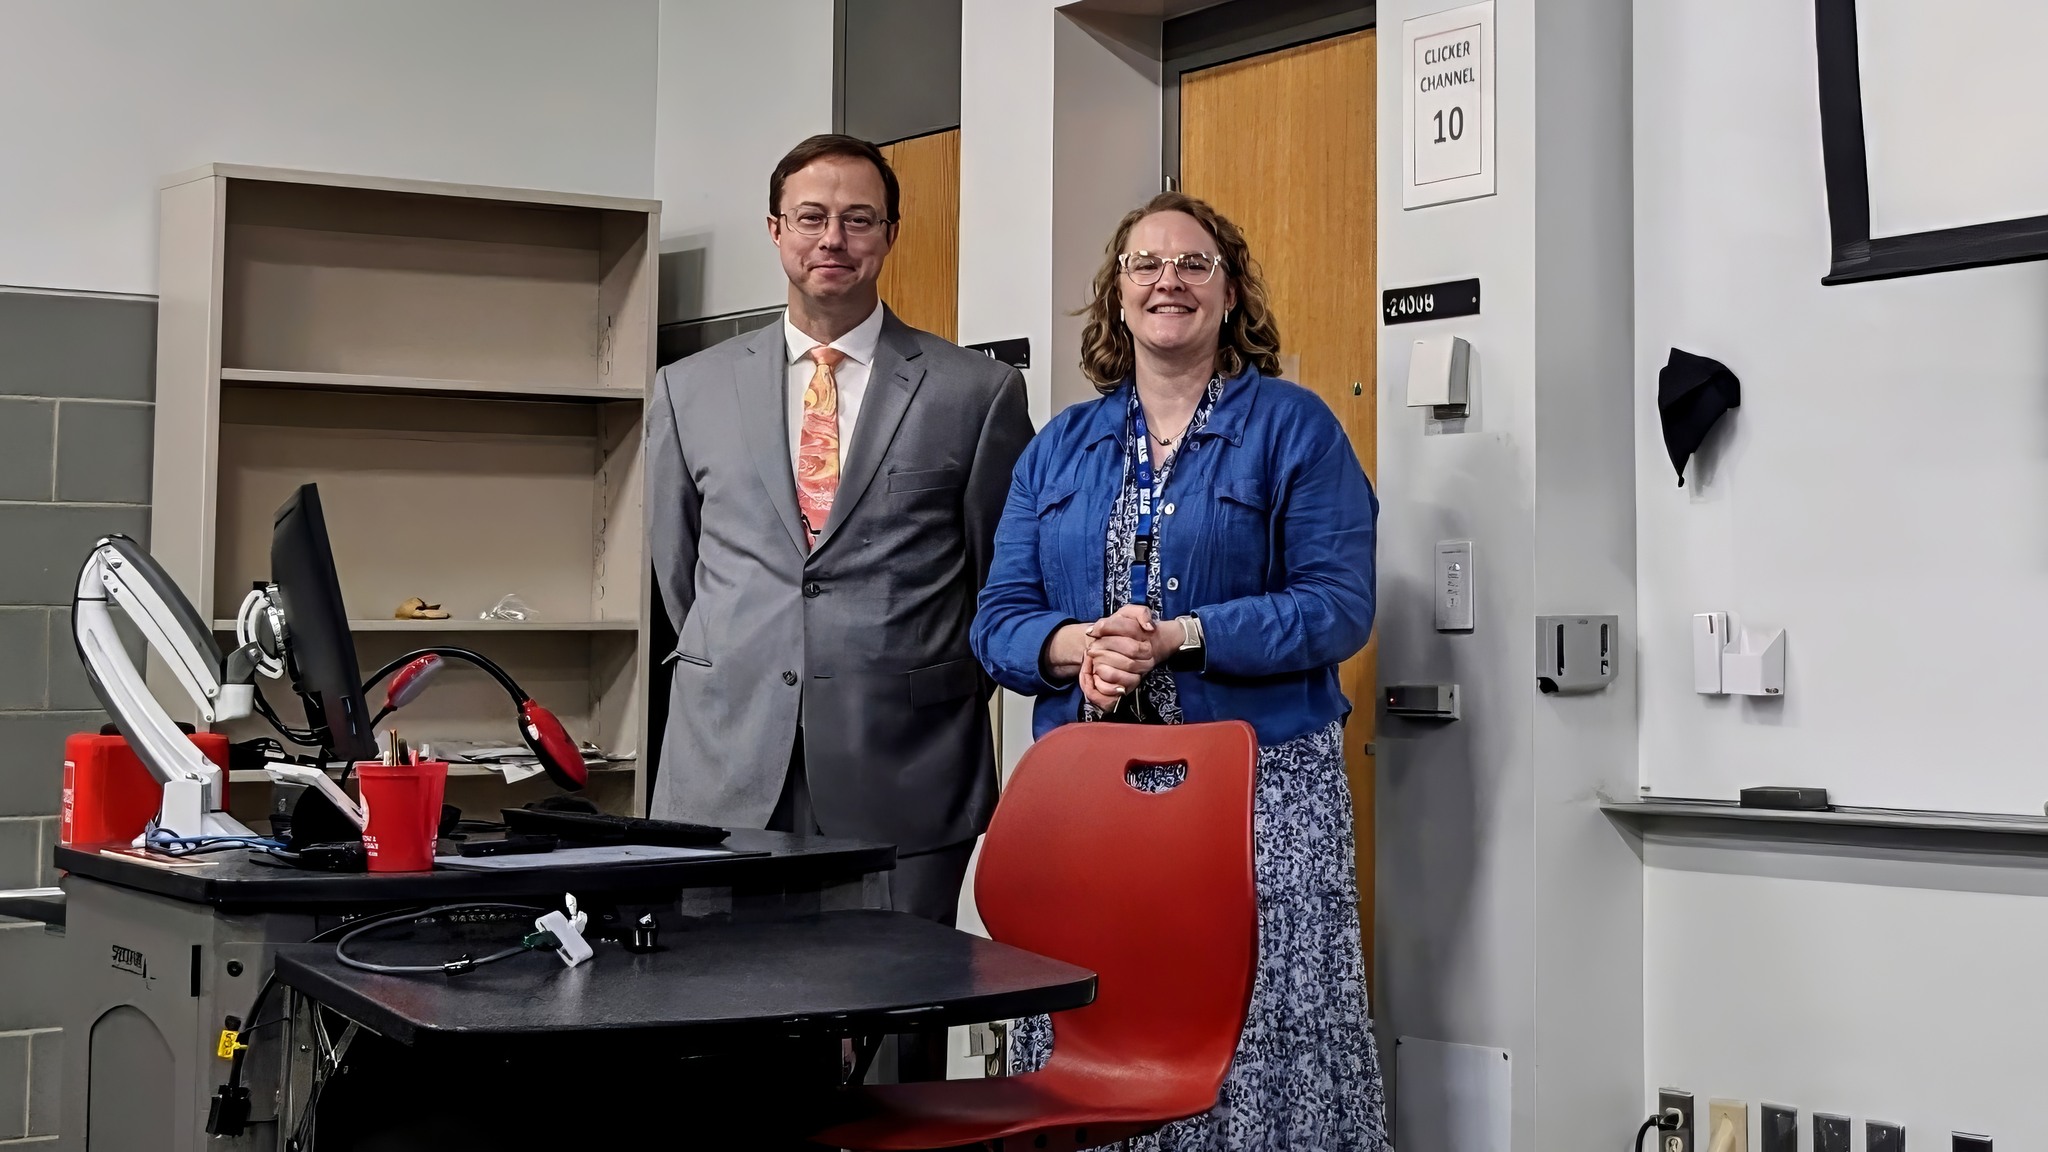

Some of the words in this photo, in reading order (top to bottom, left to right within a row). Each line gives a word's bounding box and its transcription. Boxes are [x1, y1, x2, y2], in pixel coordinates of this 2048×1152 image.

[1424, 40, 1471, 65] CLICKER
[1420, 67, 1475, 93] CHANNEL
[1433, 106, 1464, 144] 10
